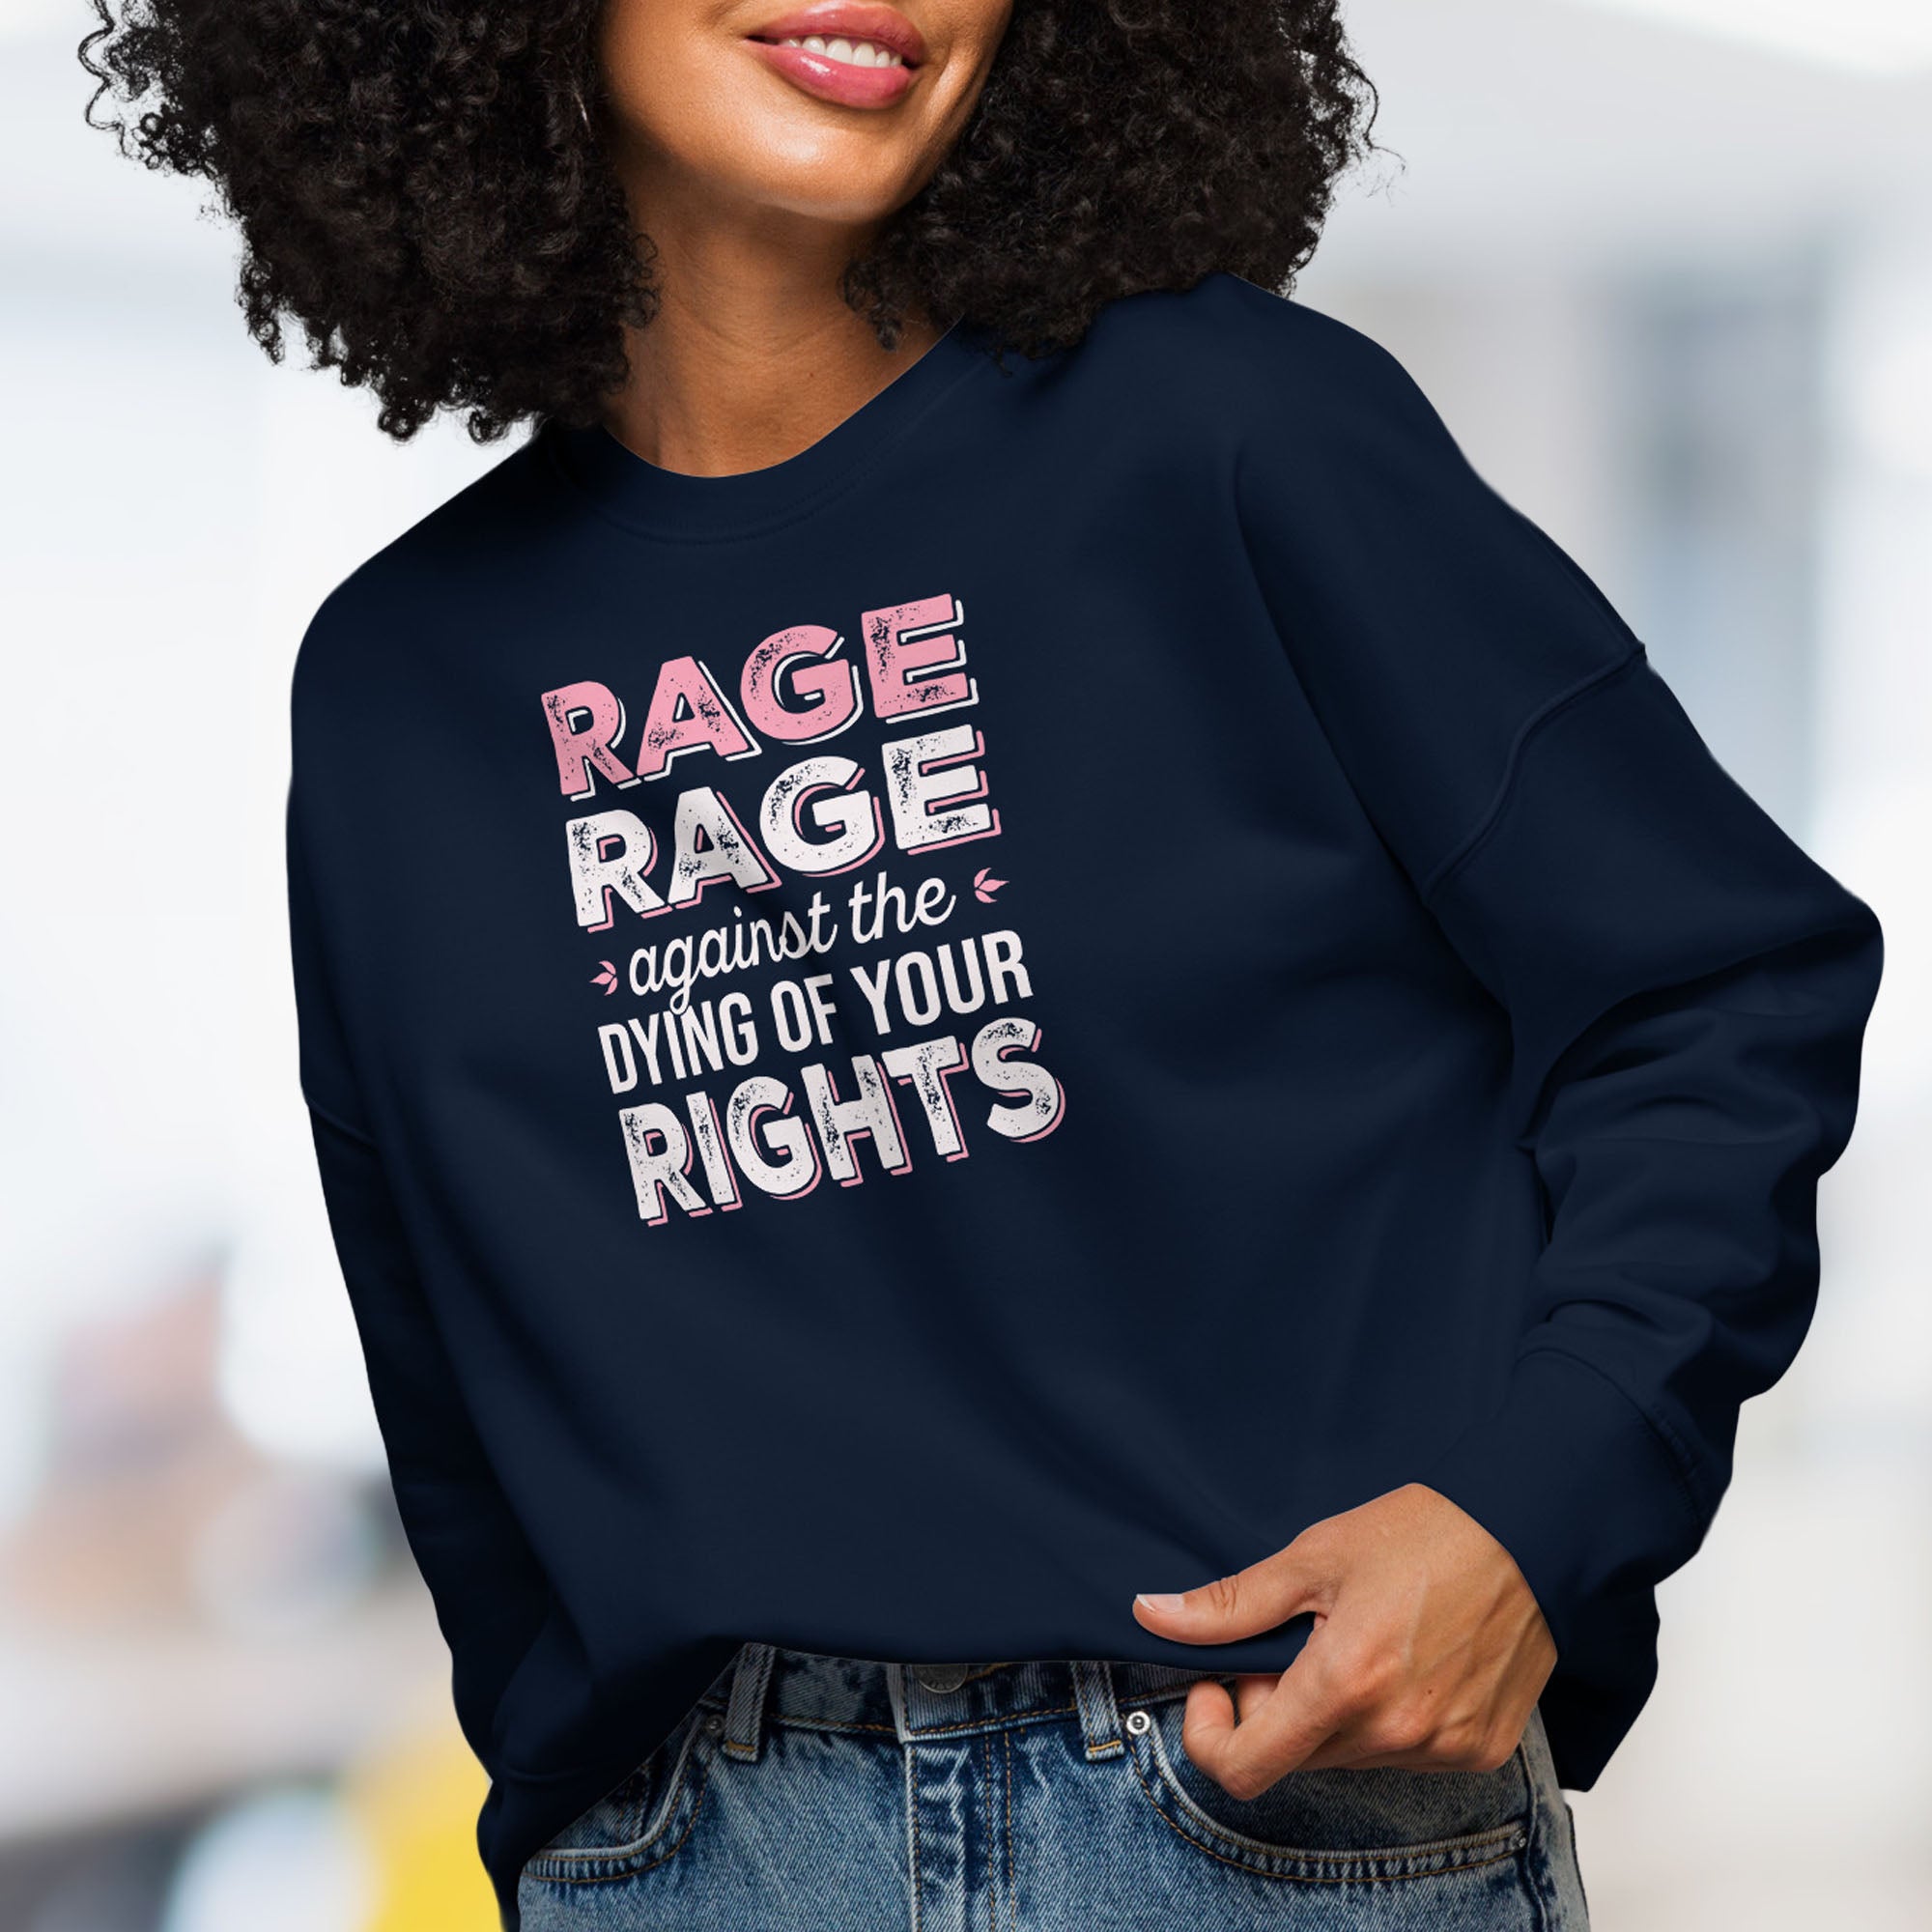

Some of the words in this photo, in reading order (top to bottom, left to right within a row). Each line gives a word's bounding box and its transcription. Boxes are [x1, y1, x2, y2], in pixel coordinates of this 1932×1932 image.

[541, 594, 980, 801] RAGE
[566, 724, 1001, 933] RAGE
[598, 992, 758, 1094] DYING
[771, 974, 836, 1052] OF
[850, 930, 1033, 1035] YOUR
[629, 892, 838, 1014] against
[848, 871, 956, 944] the
[619, 1018, 1065, 1226] RIGHTS
